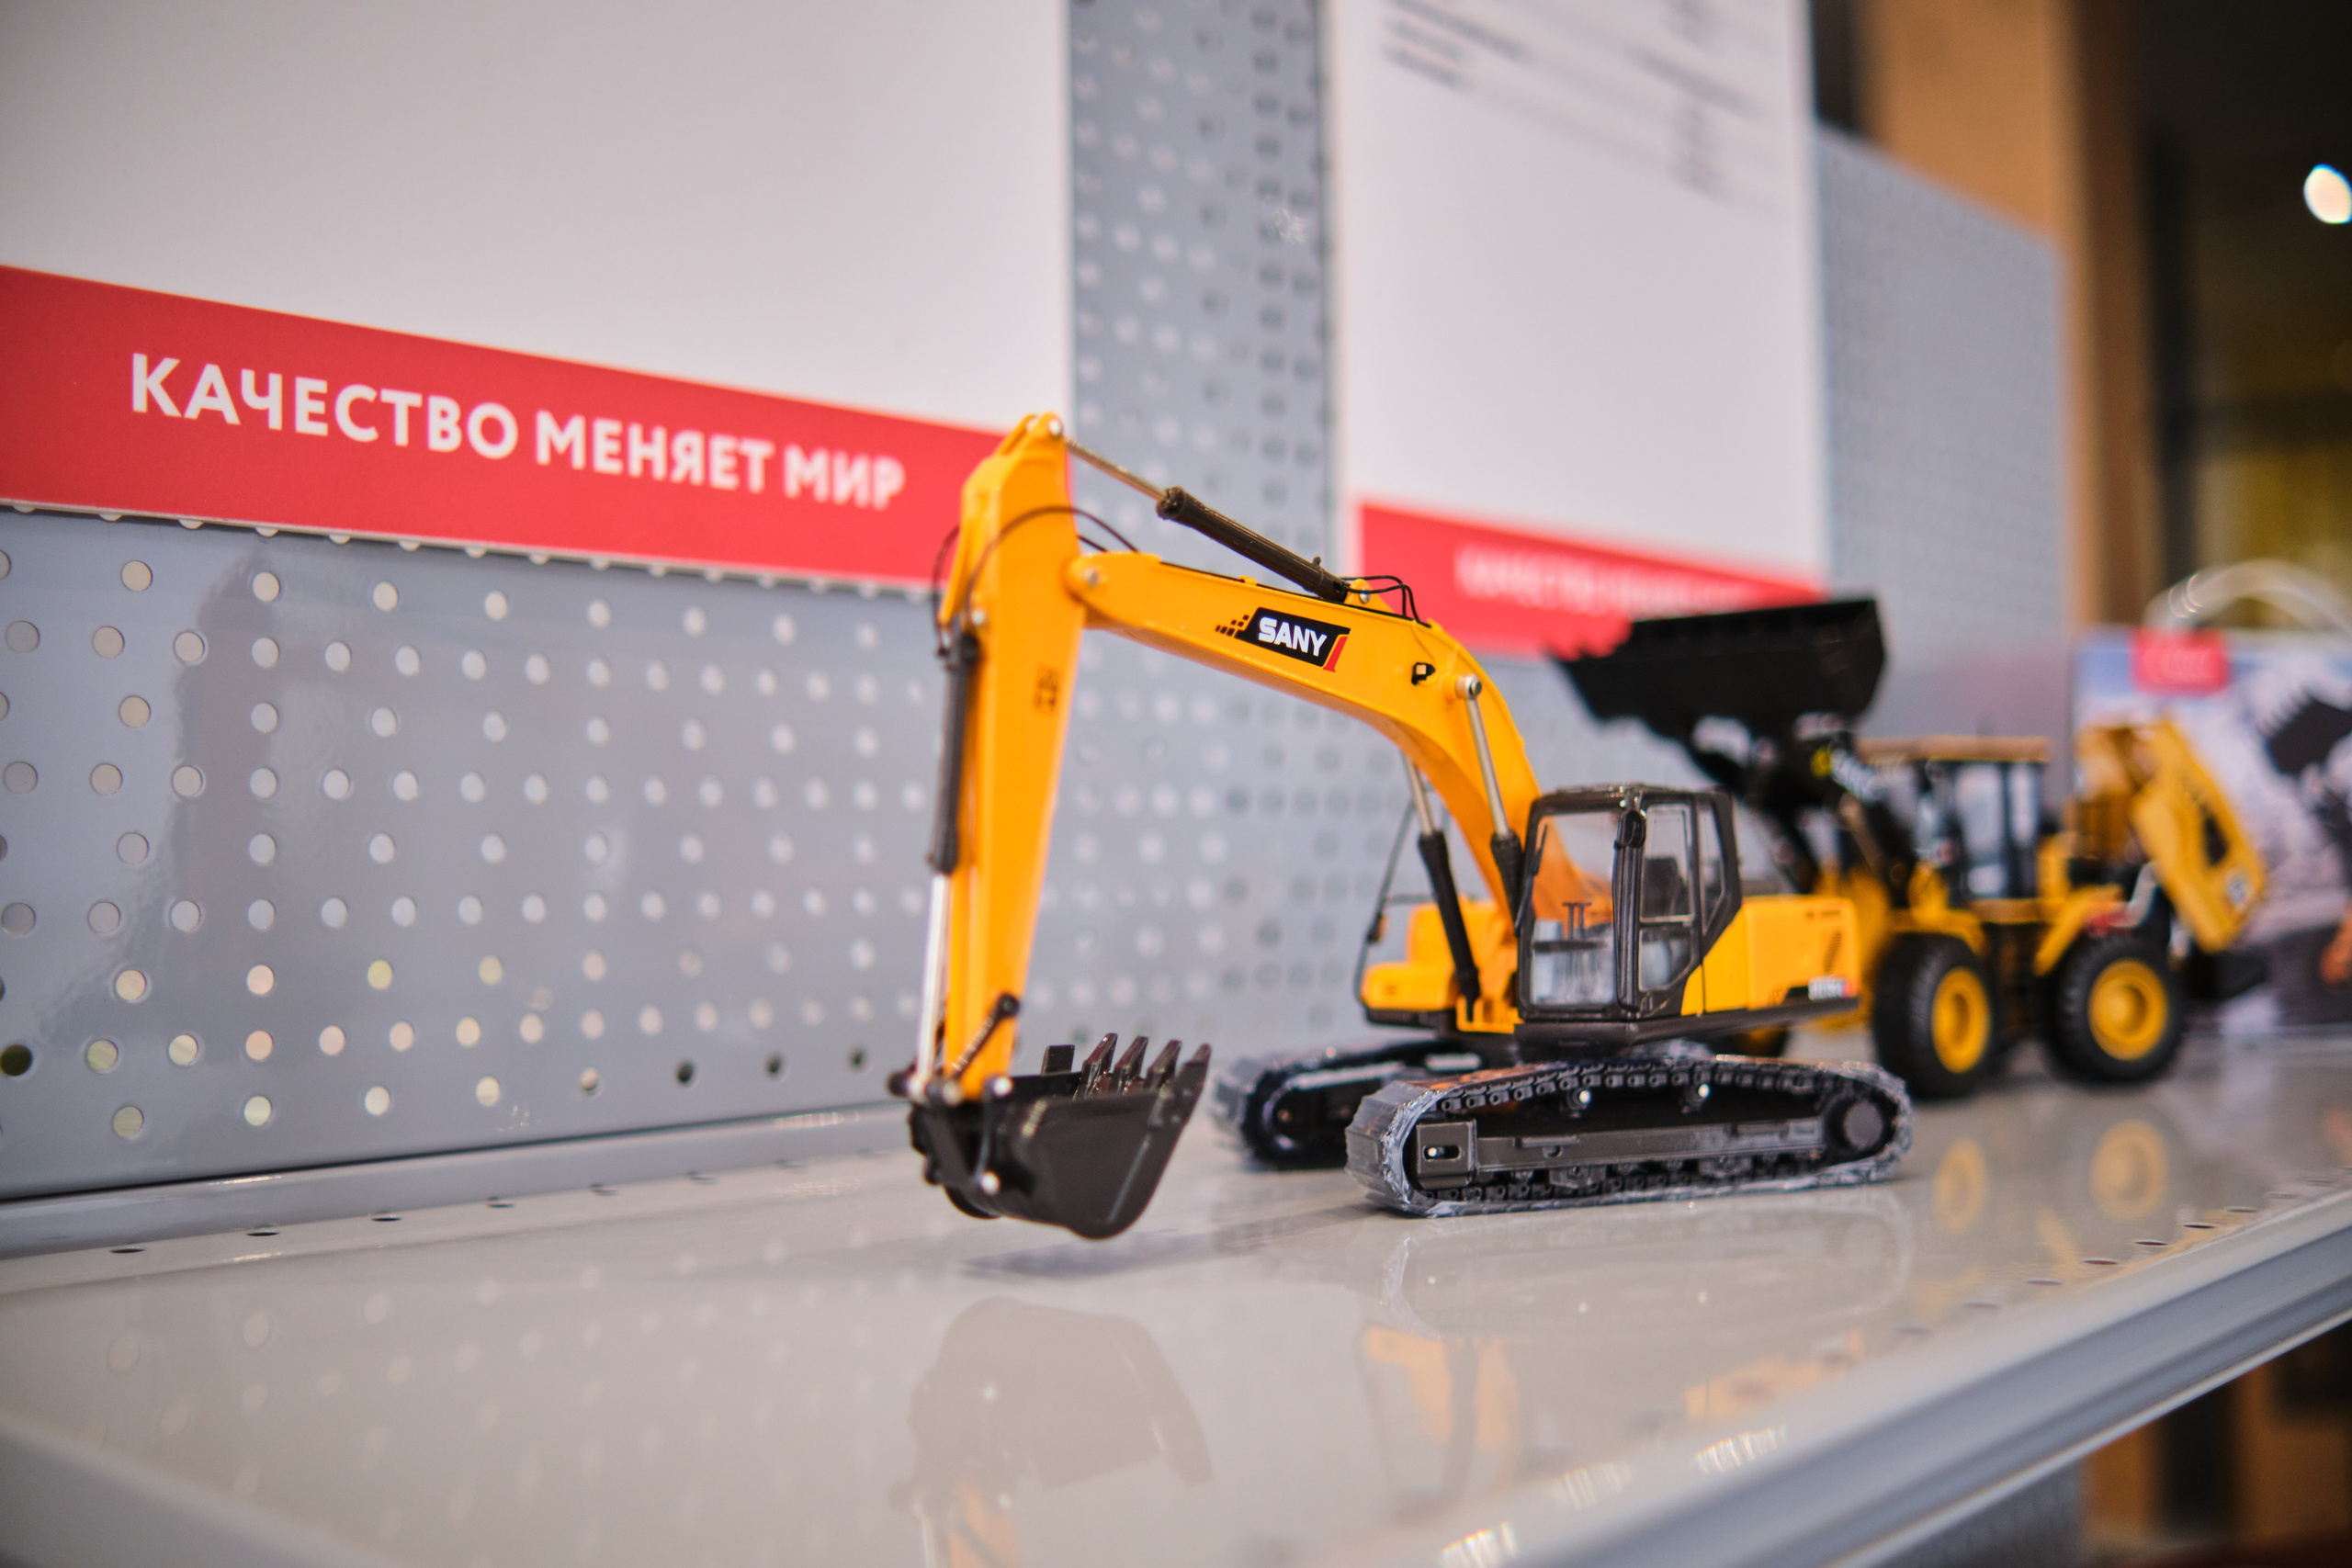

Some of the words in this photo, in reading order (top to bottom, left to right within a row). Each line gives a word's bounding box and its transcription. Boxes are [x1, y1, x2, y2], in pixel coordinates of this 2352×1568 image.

[130, 352, 518, 459] КАЧЕСТВО
[536, 410, 774, 492] МЕНЯЕТ
[784, 446, 905, 511] МИР
[1258, 616, 1327, 657] SANY
